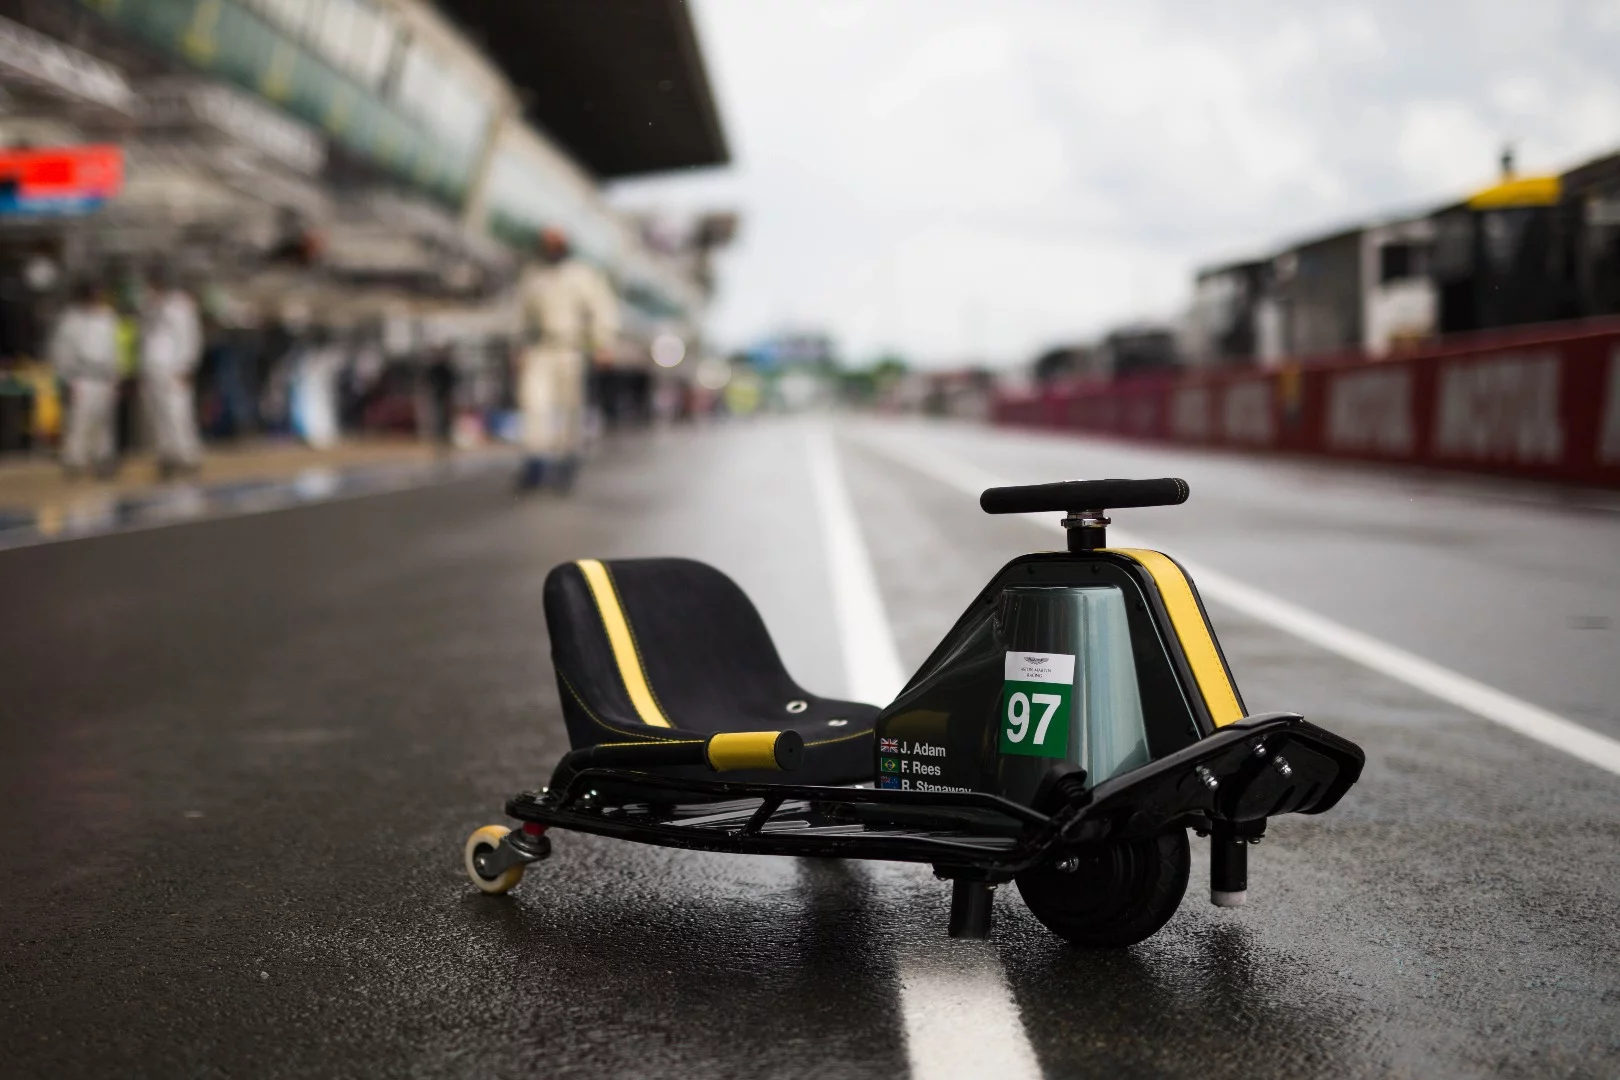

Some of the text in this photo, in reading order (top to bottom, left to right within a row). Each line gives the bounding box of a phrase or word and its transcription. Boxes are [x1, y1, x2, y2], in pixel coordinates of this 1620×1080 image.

[1006, 691, 1062, 745] 97
[900, 741, 946, 757] J. Adam
[901, 760, 941, 776] F. Rees
[901, 779, 913, 792] R.
